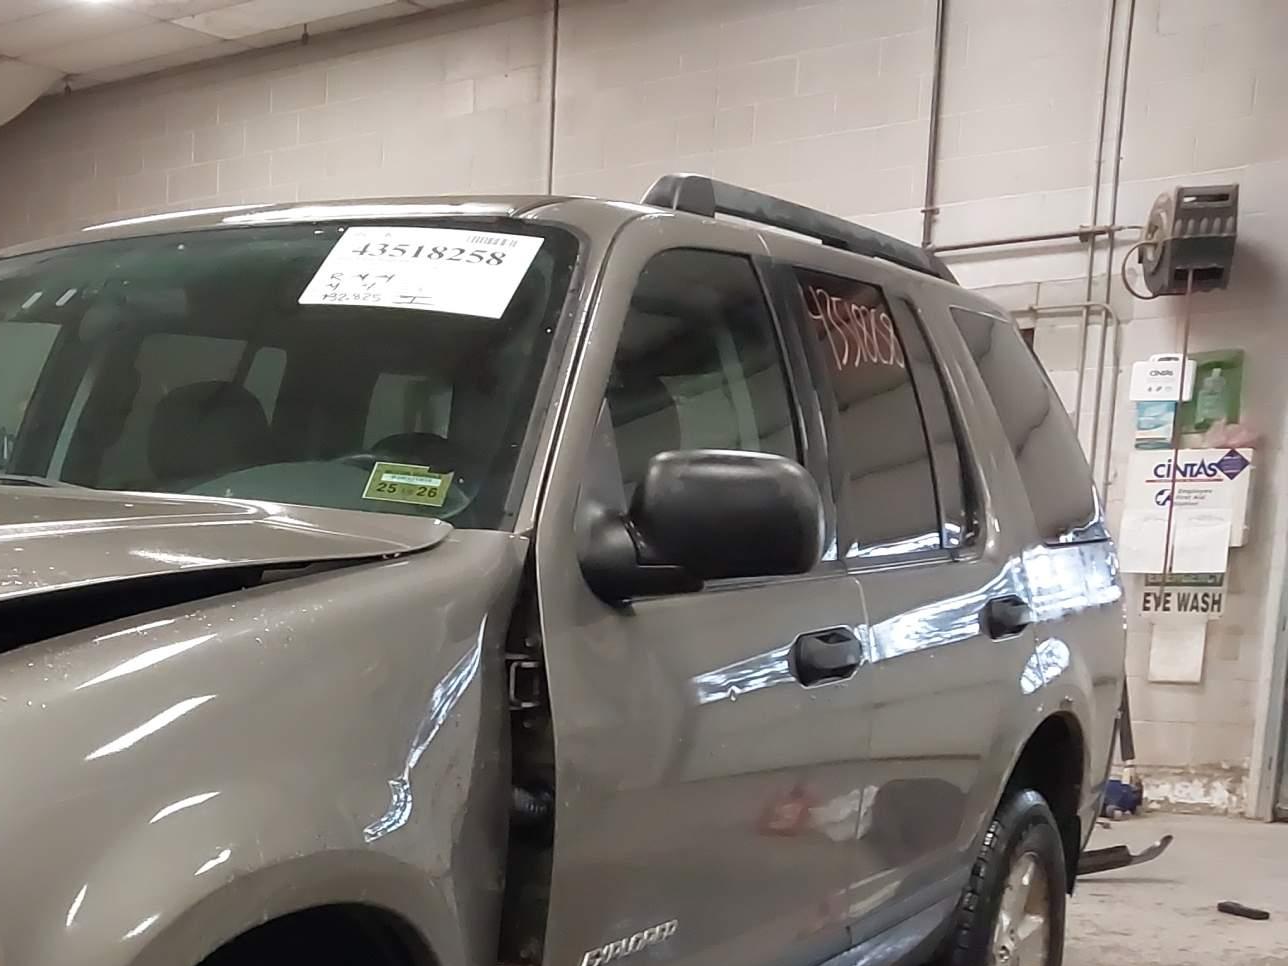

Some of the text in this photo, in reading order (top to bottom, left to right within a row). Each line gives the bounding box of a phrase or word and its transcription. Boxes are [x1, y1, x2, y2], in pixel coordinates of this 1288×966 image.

[352, 242, 506, 267] 43518258
[376, 482, 398, 494] 25
[416, 486, 438, 498] 26
[1142, 592, 1222, 612] EYE WASH
